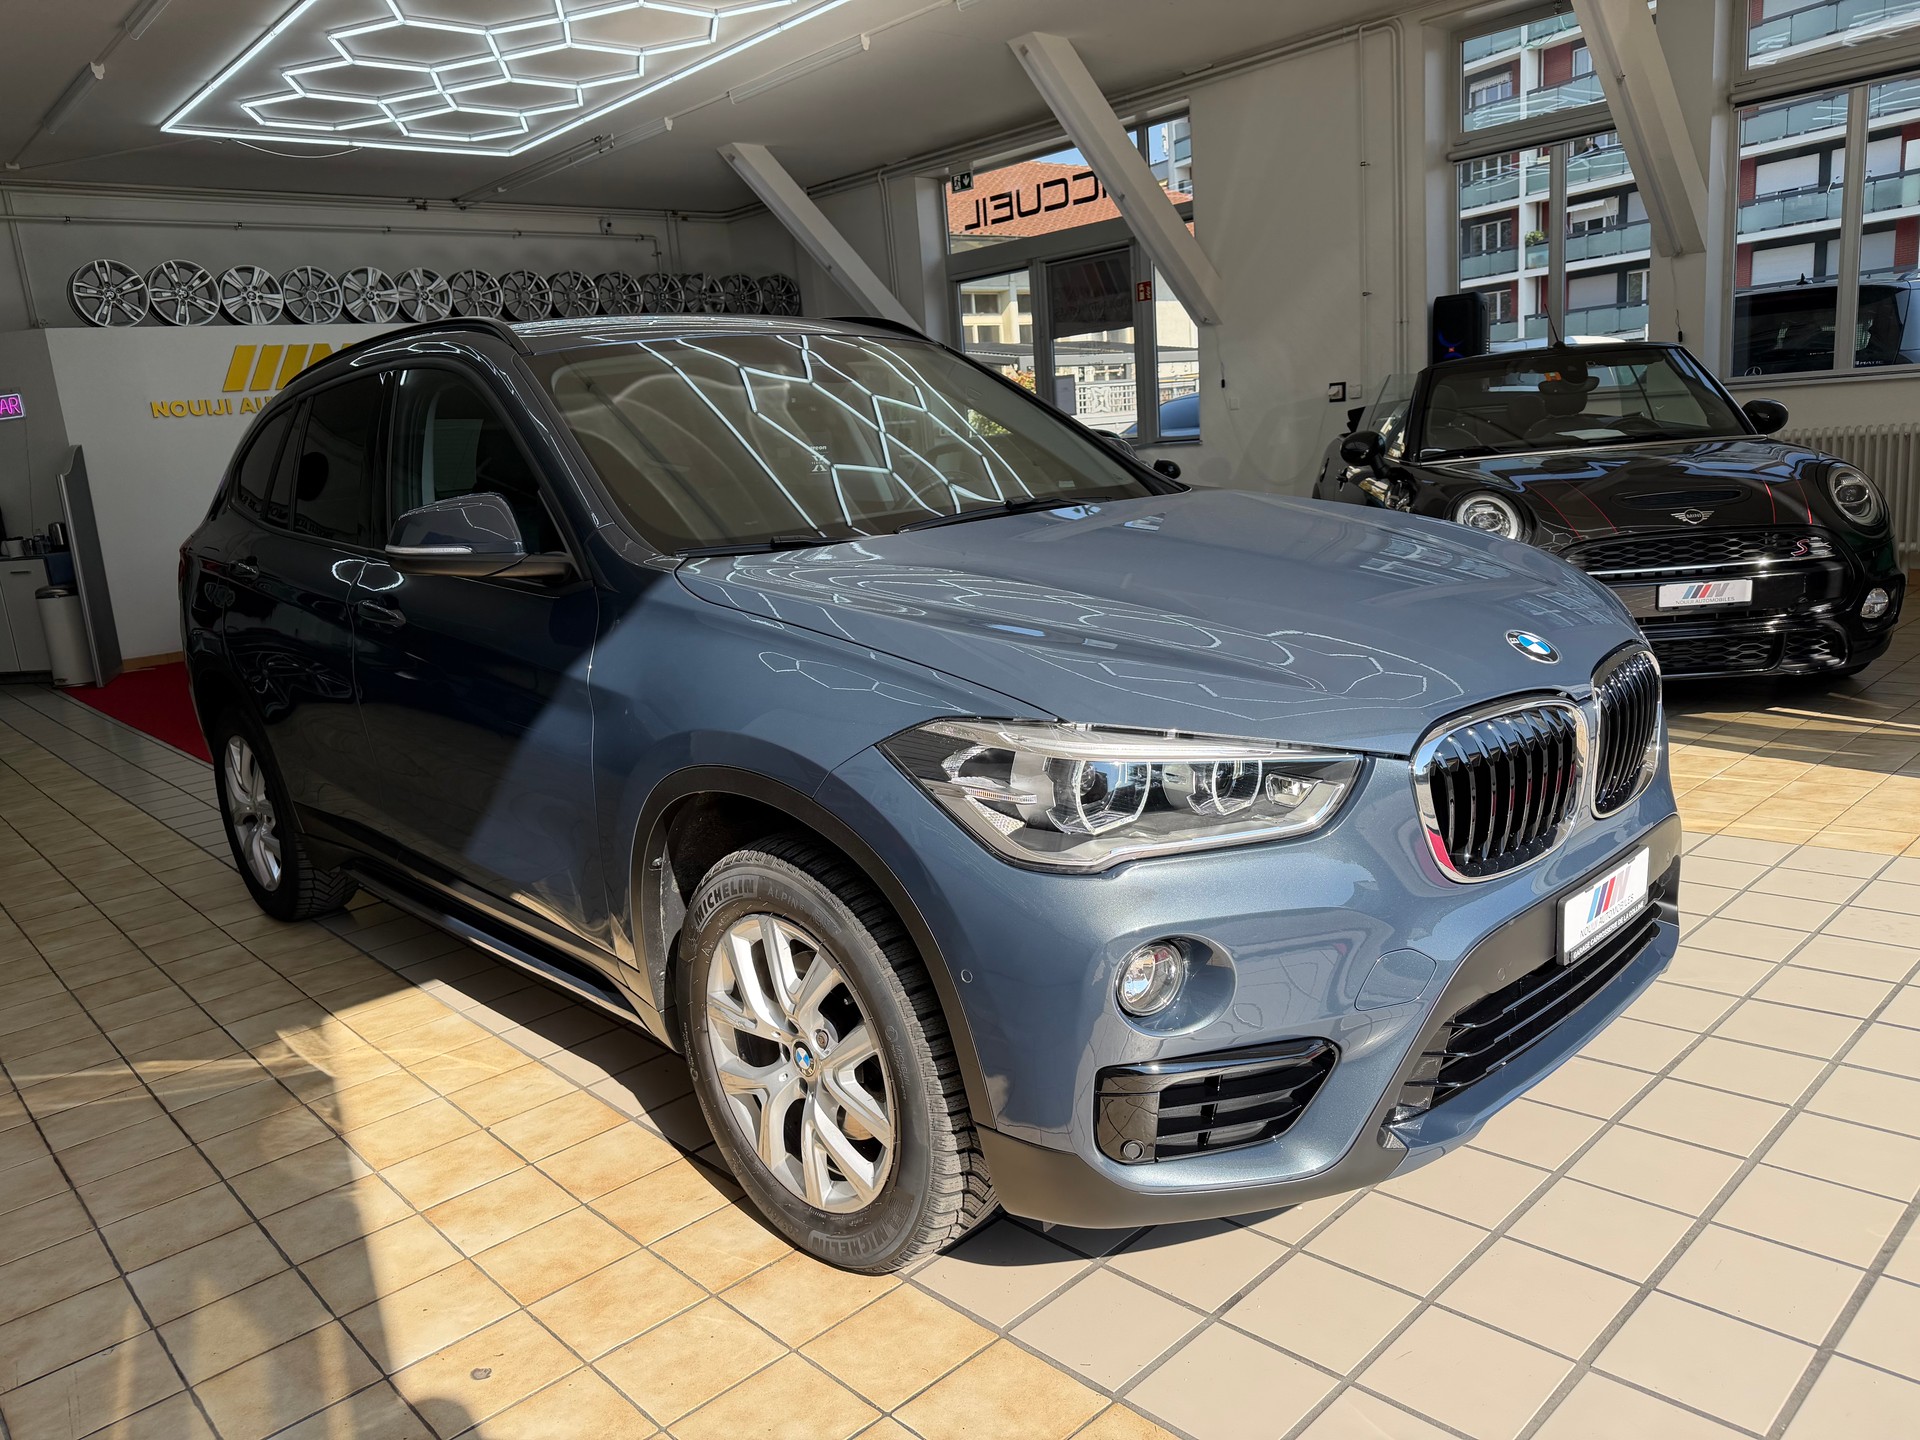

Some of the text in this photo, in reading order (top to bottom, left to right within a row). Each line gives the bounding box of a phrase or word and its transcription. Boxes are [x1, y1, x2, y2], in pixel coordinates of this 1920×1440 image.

[0, 397, 21, 414] AR
[150, 399, 233, 418] NOUIJI
[694, 879, 755, 926] MICHELIN
[767, 887, 799, 909] ALPIN
[812, 1223, 889, 1258] MICHELIN
